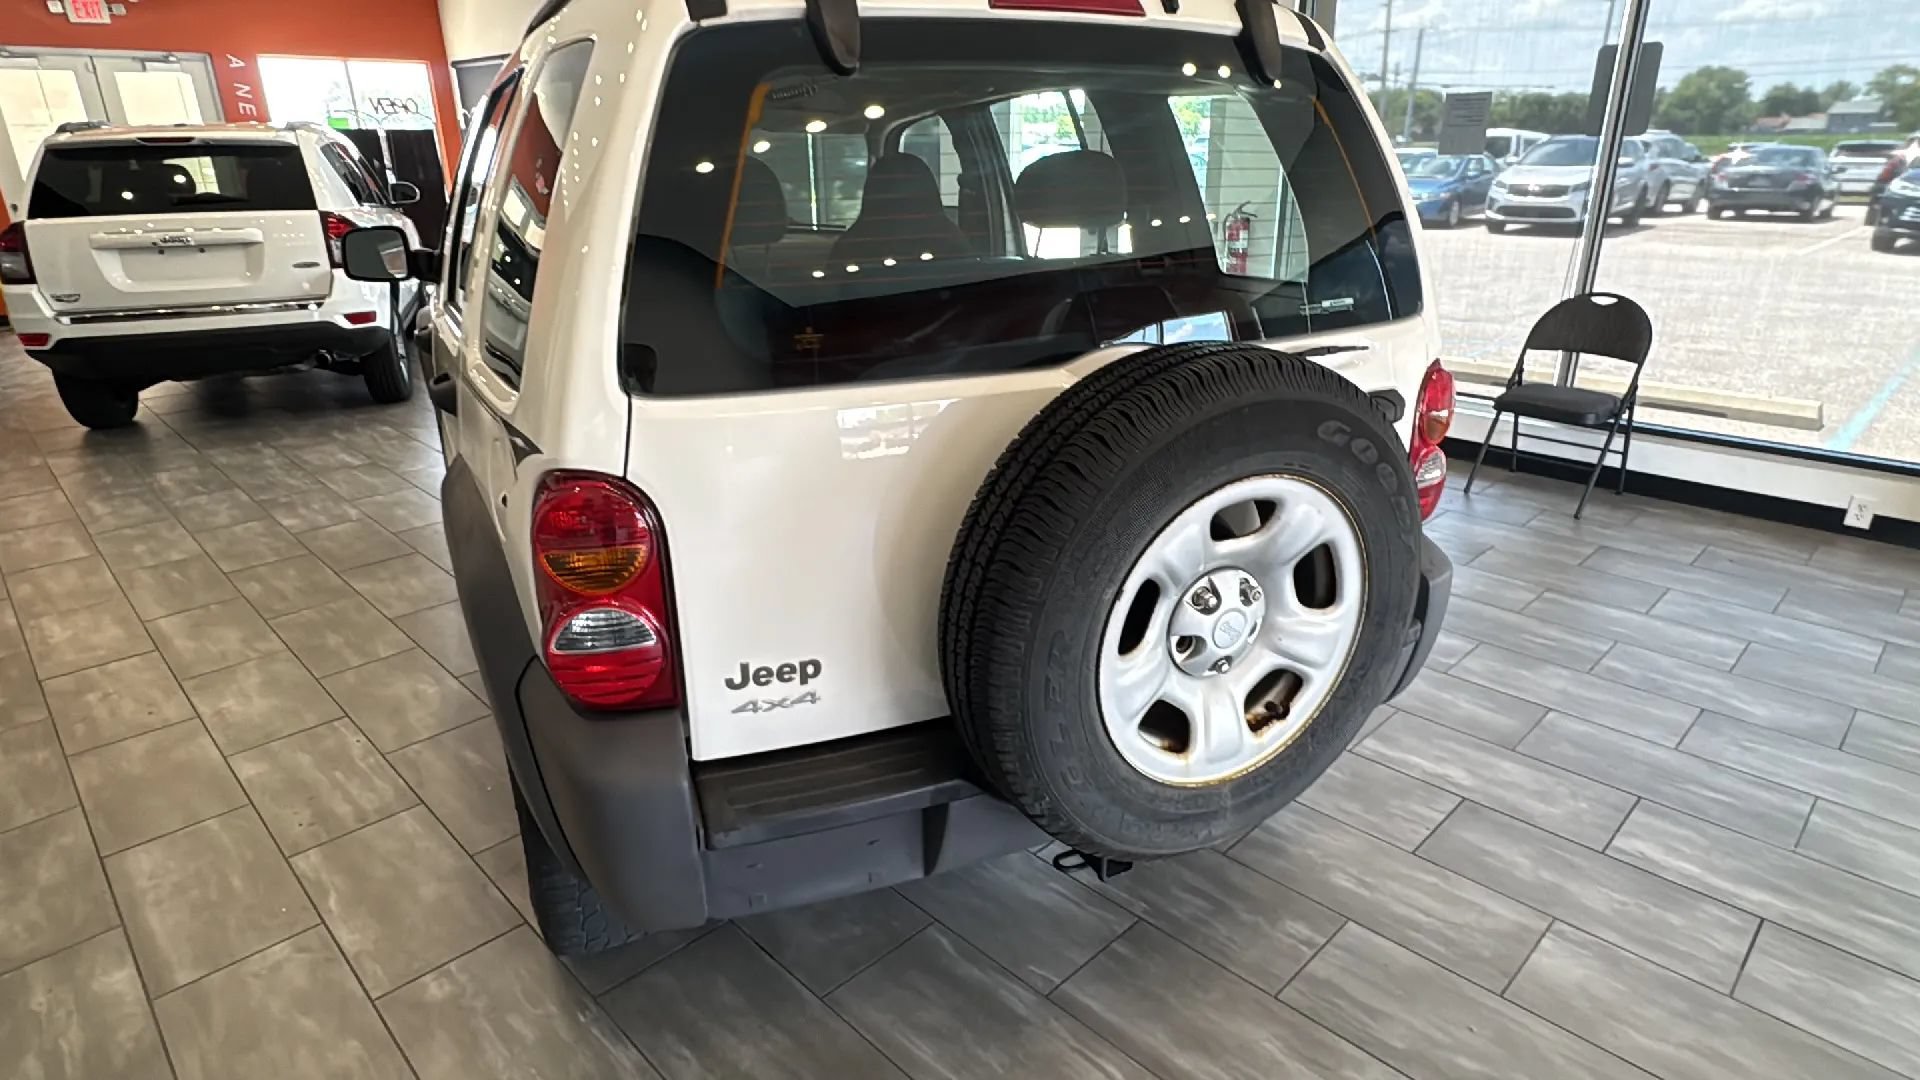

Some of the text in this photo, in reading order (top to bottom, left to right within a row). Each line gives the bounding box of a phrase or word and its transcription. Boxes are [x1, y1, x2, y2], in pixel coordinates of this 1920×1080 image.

[226, 54, 246, 67] A
[724, 658, 822, 691] Jeep
[731, 689, 821, 714] 4x4
